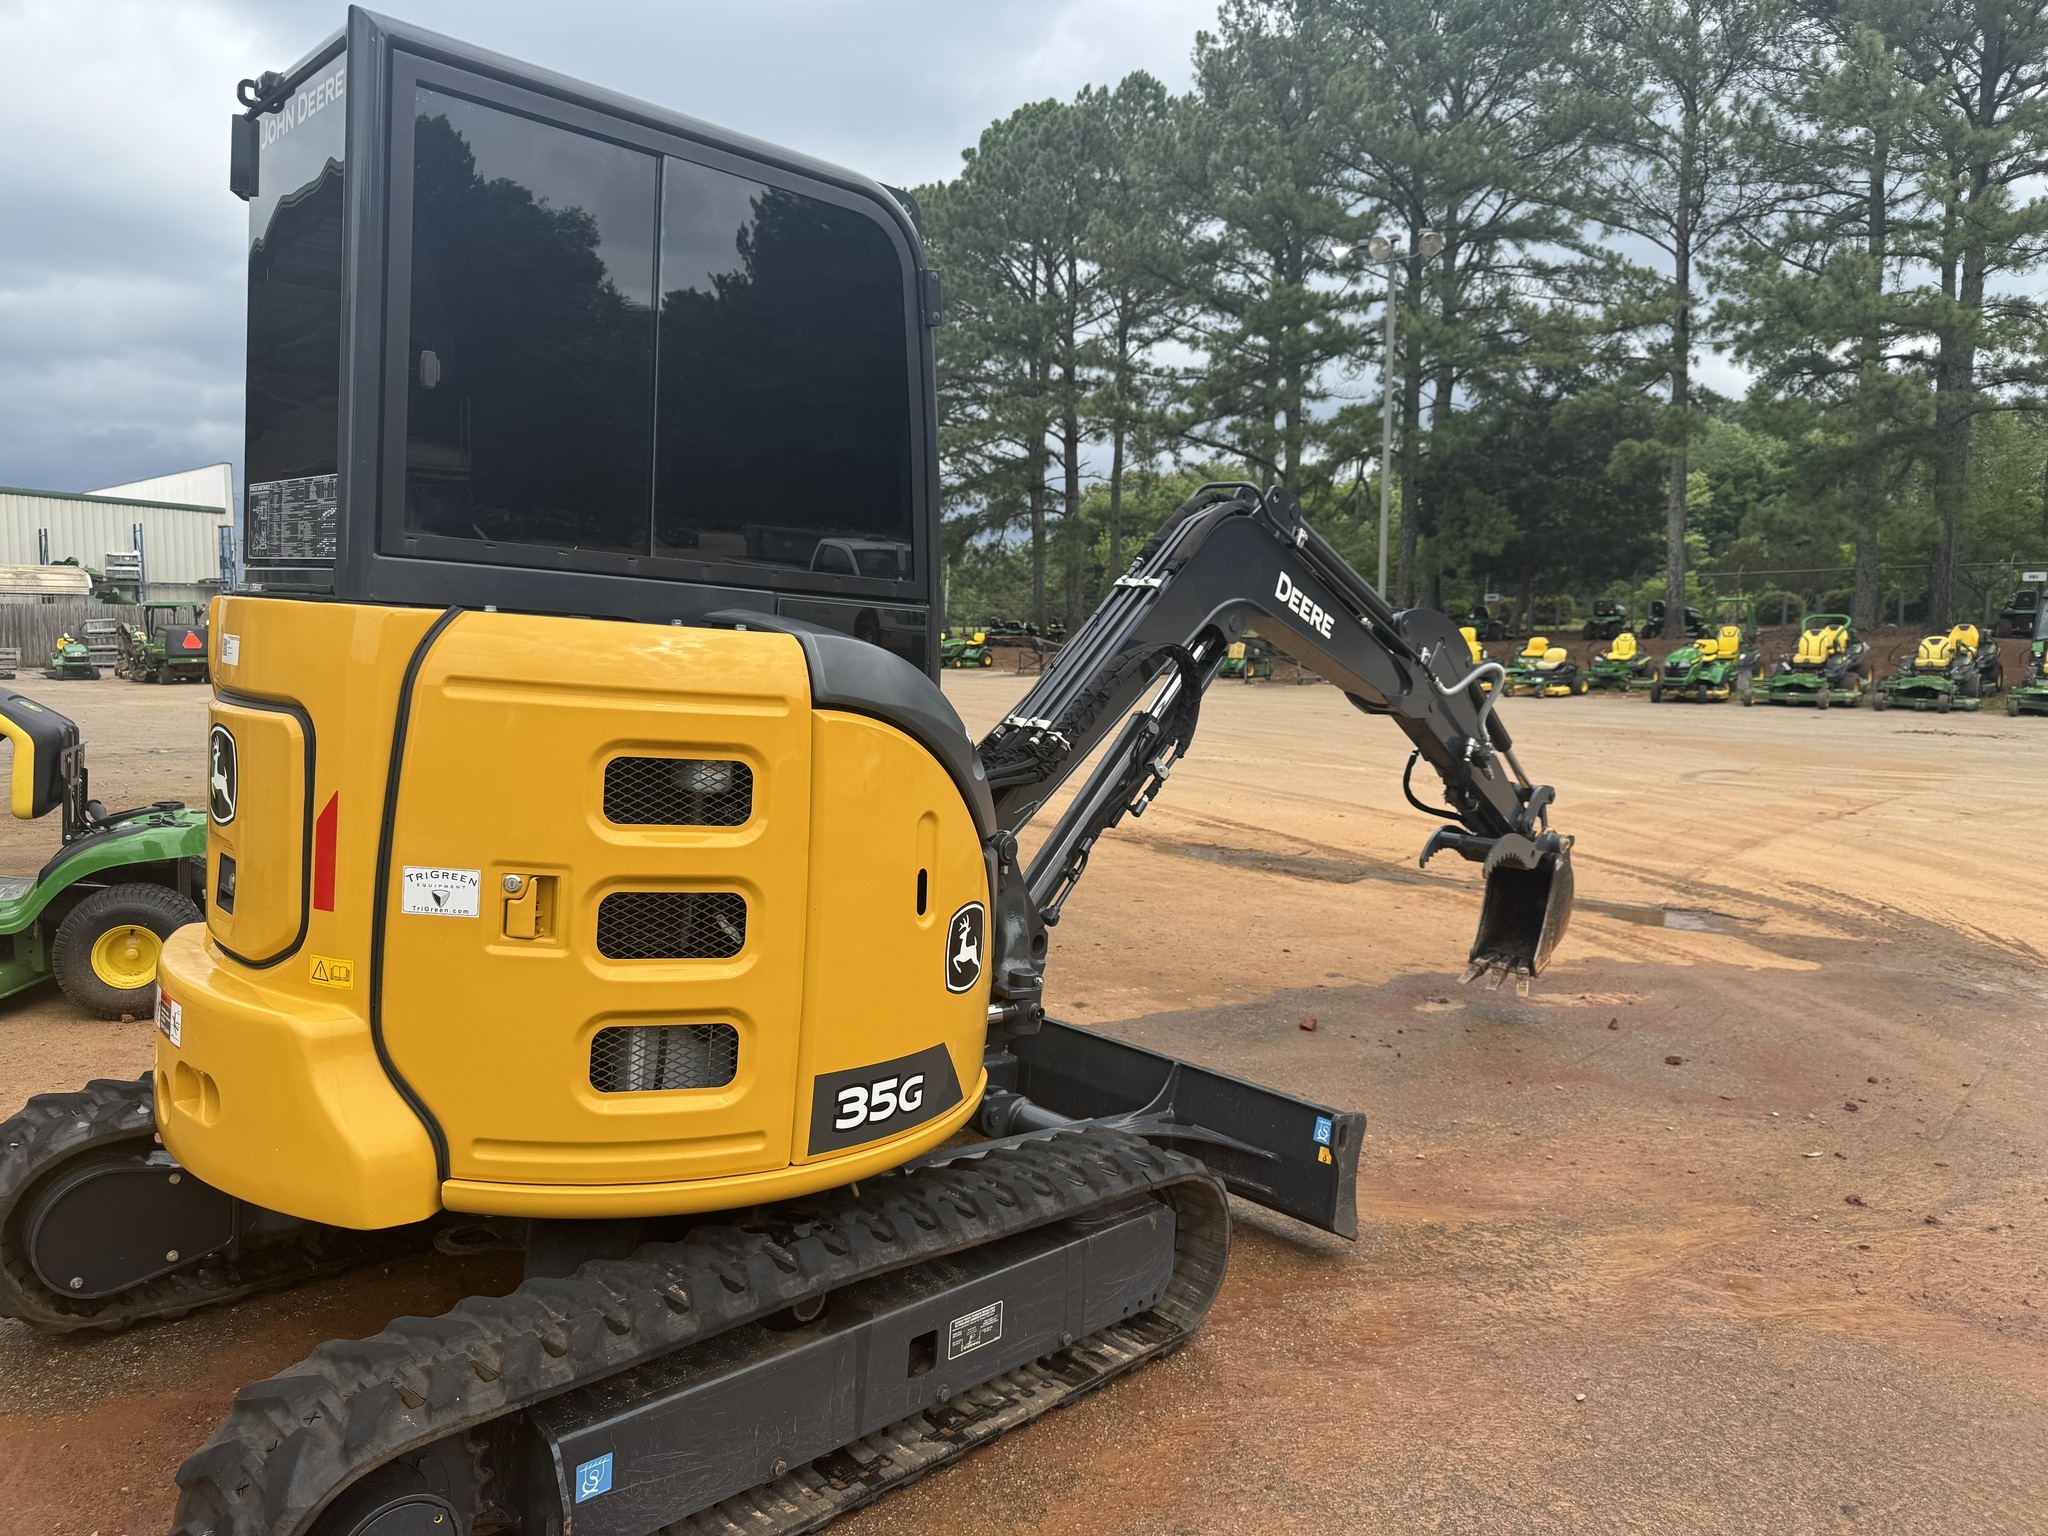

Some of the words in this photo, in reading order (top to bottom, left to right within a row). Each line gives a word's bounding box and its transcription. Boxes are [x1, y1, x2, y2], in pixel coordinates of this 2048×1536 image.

[261, 104, 295, 150] JOHN
[297, 67, 345, 125] DEERE
[1274, 570, 1336, 640] DEERE
[406, 870, 478, 887] TRIGREEN
[416, 882, 466, 890] EQUIPMENT
[412, 905, 470, 914] TriGreen.com
[834, 1074, 924, 1130] 35G
